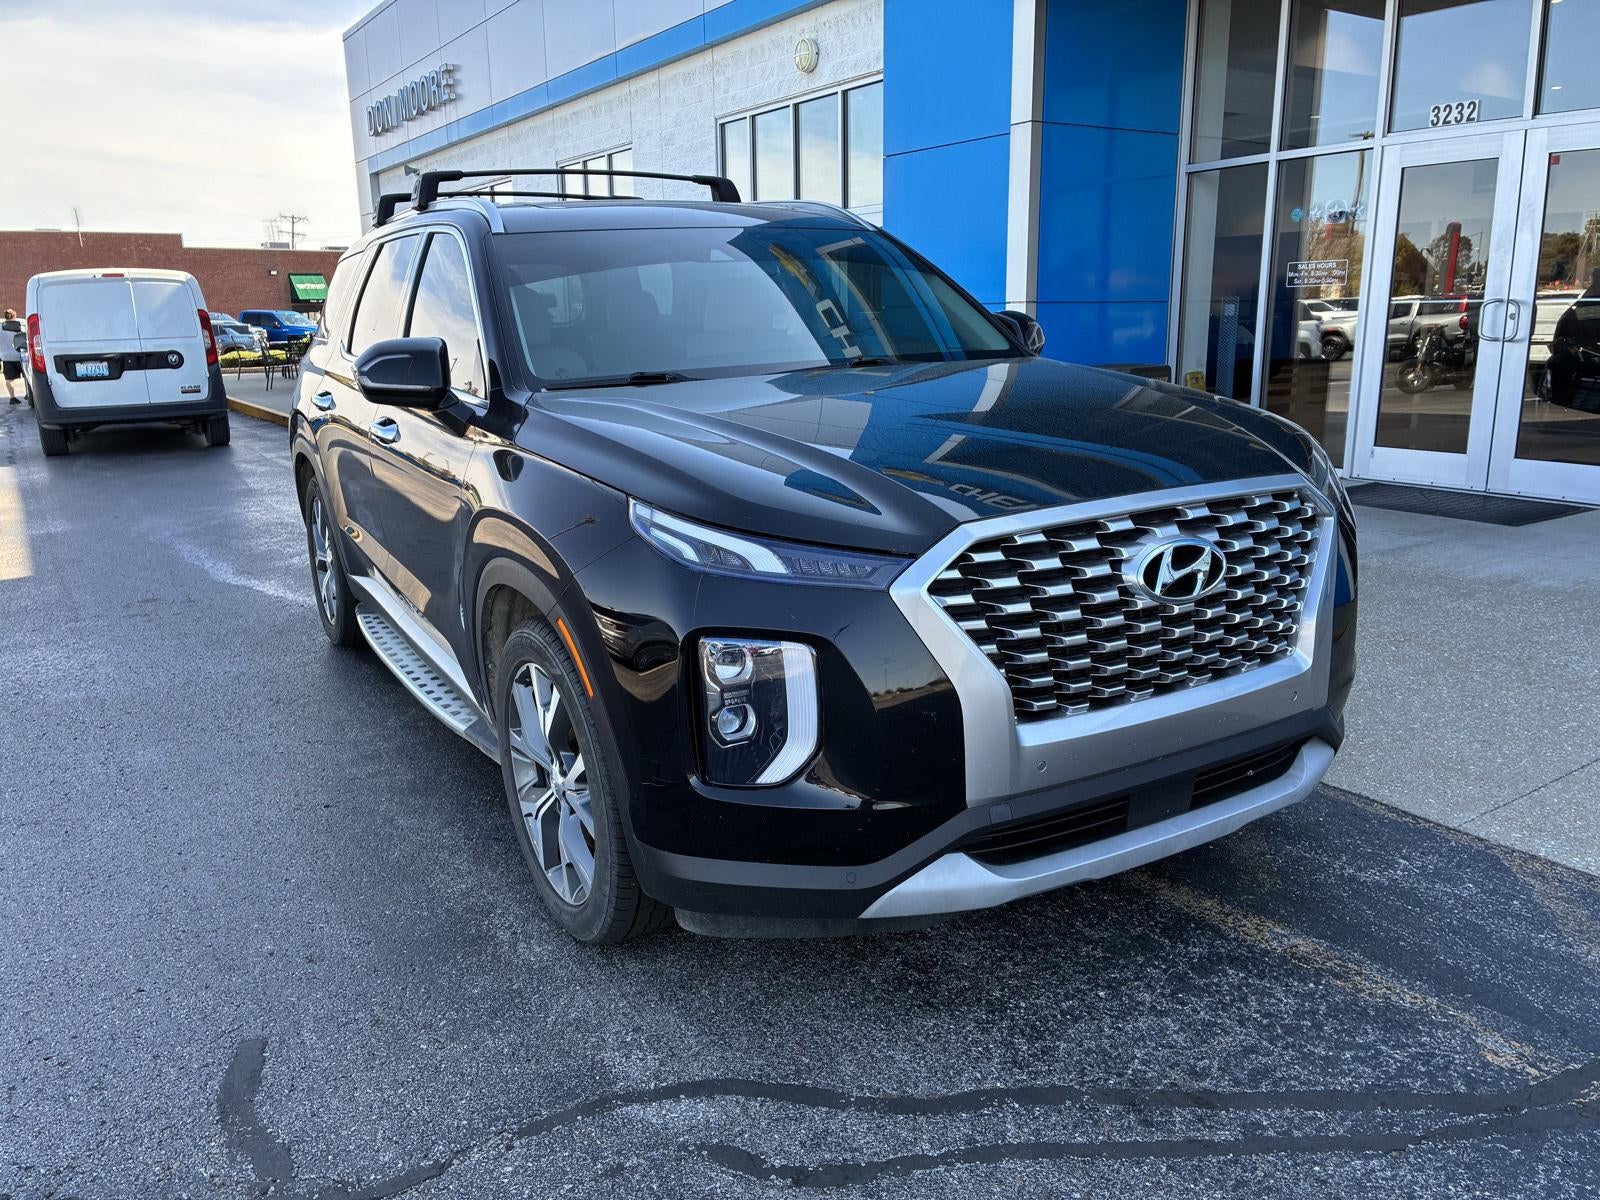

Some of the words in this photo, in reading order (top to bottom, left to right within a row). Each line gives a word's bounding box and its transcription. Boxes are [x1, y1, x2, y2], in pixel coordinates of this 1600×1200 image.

[366, 95, 397, 137] DON
[398, 63, 456, 121] MOORE
[1430, 100, 1478, 127] 3232
